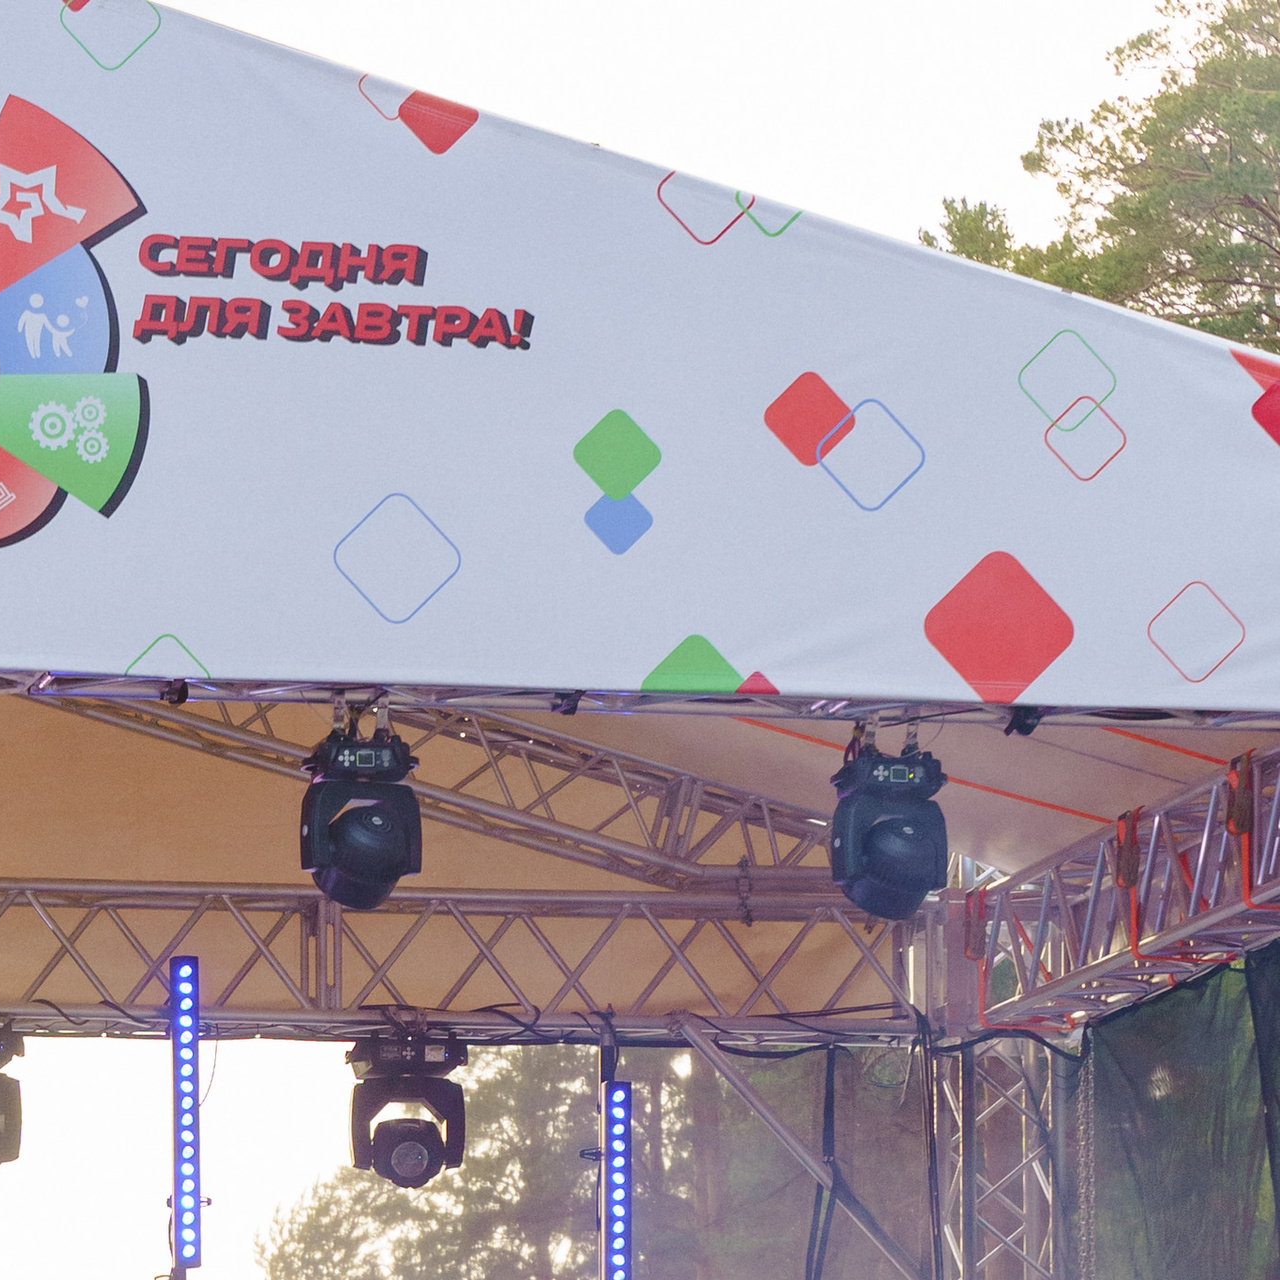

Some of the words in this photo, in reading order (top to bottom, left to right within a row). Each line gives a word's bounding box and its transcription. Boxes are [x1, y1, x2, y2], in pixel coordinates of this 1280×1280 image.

[138, 233, 428, 290] СЕГОДНЯ
[132, 294, 271, 345] ДЛЯ
[277, 299, 535, 350] ЗАВТРА!
